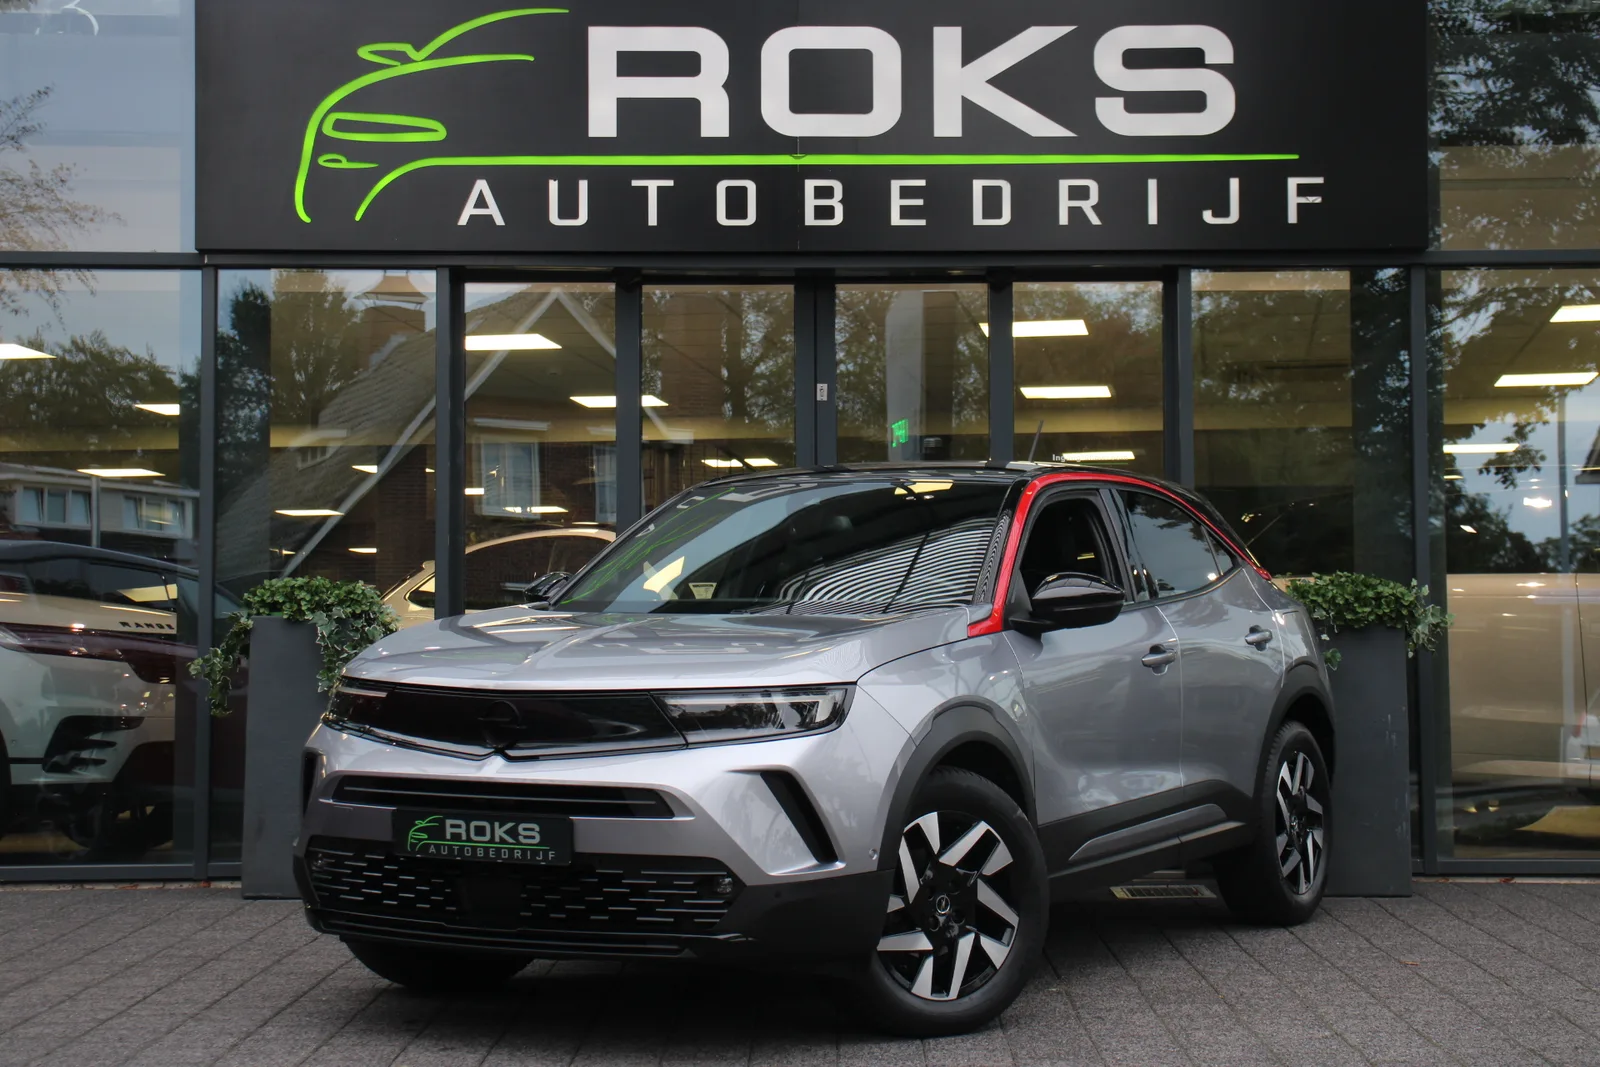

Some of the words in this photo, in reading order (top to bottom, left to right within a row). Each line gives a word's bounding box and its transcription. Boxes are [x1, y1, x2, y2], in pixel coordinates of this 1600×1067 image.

[588, 24, 1236, 138] ROKS
[457, 176, 1325, 226] AUTOBEDRIJF
[445, 819, 541, 844] ROKS
[428, 844, 556, 861] AUTOBEDRIJF
